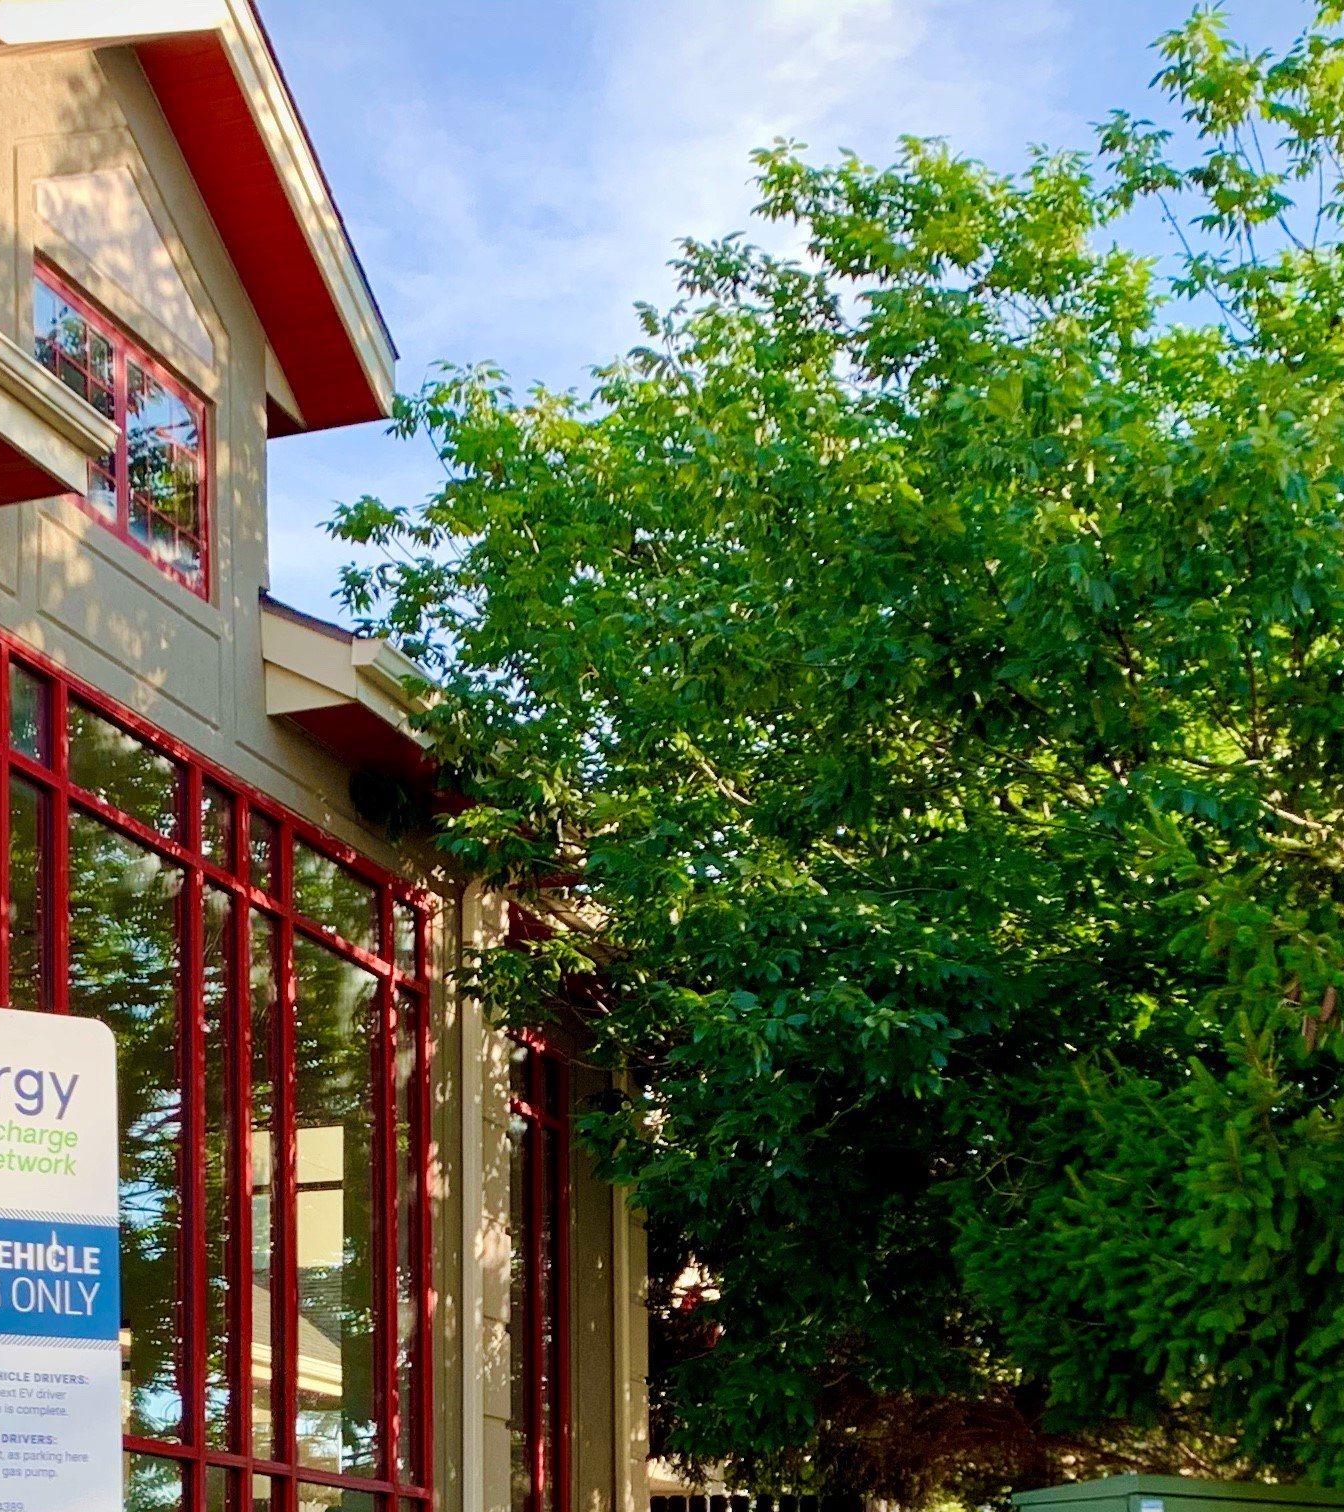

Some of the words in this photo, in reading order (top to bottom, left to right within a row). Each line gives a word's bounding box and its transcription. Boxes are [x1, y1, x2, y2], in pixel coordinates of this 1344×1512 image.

[11, 1276, 100, 1316] ONLY
[33, 1372, 89, 1385] DRIVERS:
[19, 1388, 34, 1399] EV
[36, 1389, 66, 1400] driver
[4, 1404, 14, 1414] is
[1, 1433, 58, 1445] DRIVERS:
[7, 1451, 20, 1460] as
[23, 1451, 62, 1463] parking
[64, 1451, 89, 1462] here
[2, 1467, 22, 1478] gas
